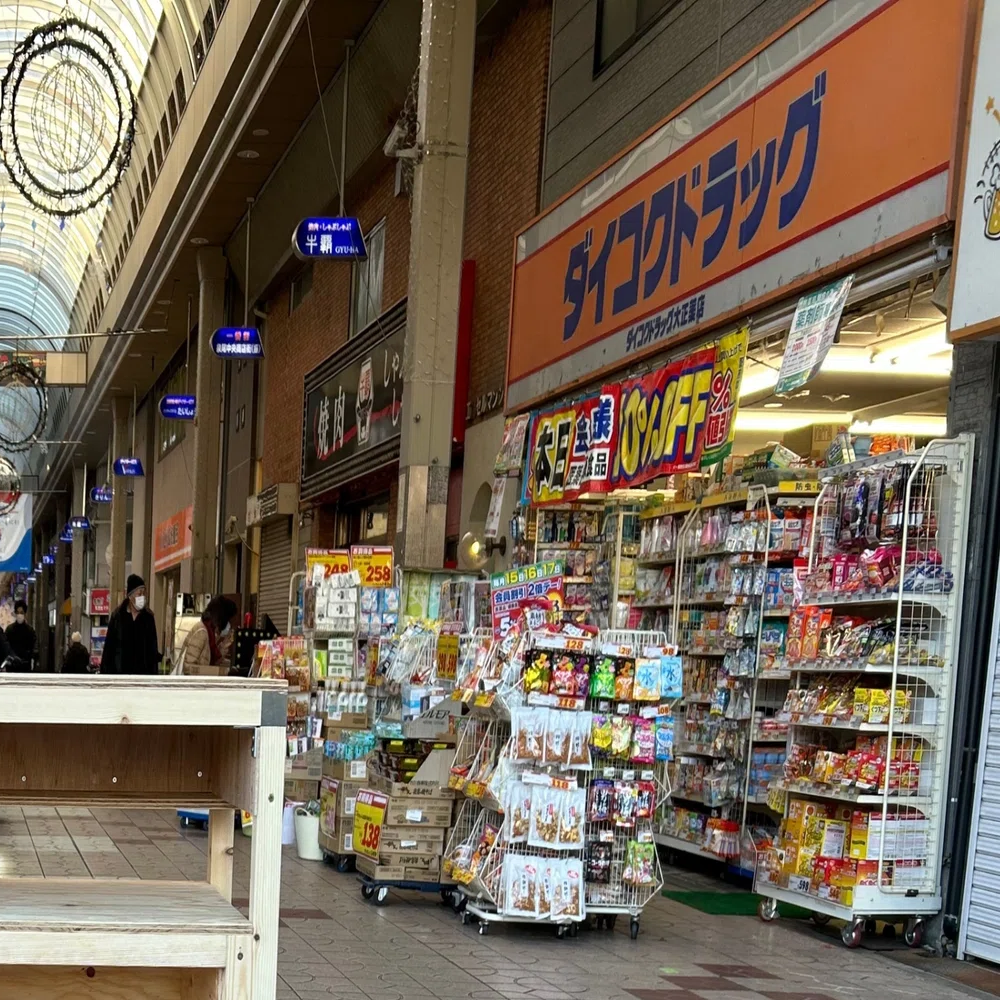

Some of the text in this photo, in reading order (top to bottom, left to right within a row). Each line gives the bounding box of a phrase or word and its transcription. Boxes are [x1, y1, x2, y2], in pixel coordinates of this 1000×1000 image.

[562, 70, 827, 342] ダイコクドラッグ
[317, 385, 346, 460] 焼肉
[535, 421, 571, 495] 本日
[365, 566, 391, 582] 258
[565, 640, 584, 649] 128
[558, 699, 576, 708] 118
[360, 821, 380, 850] 138
